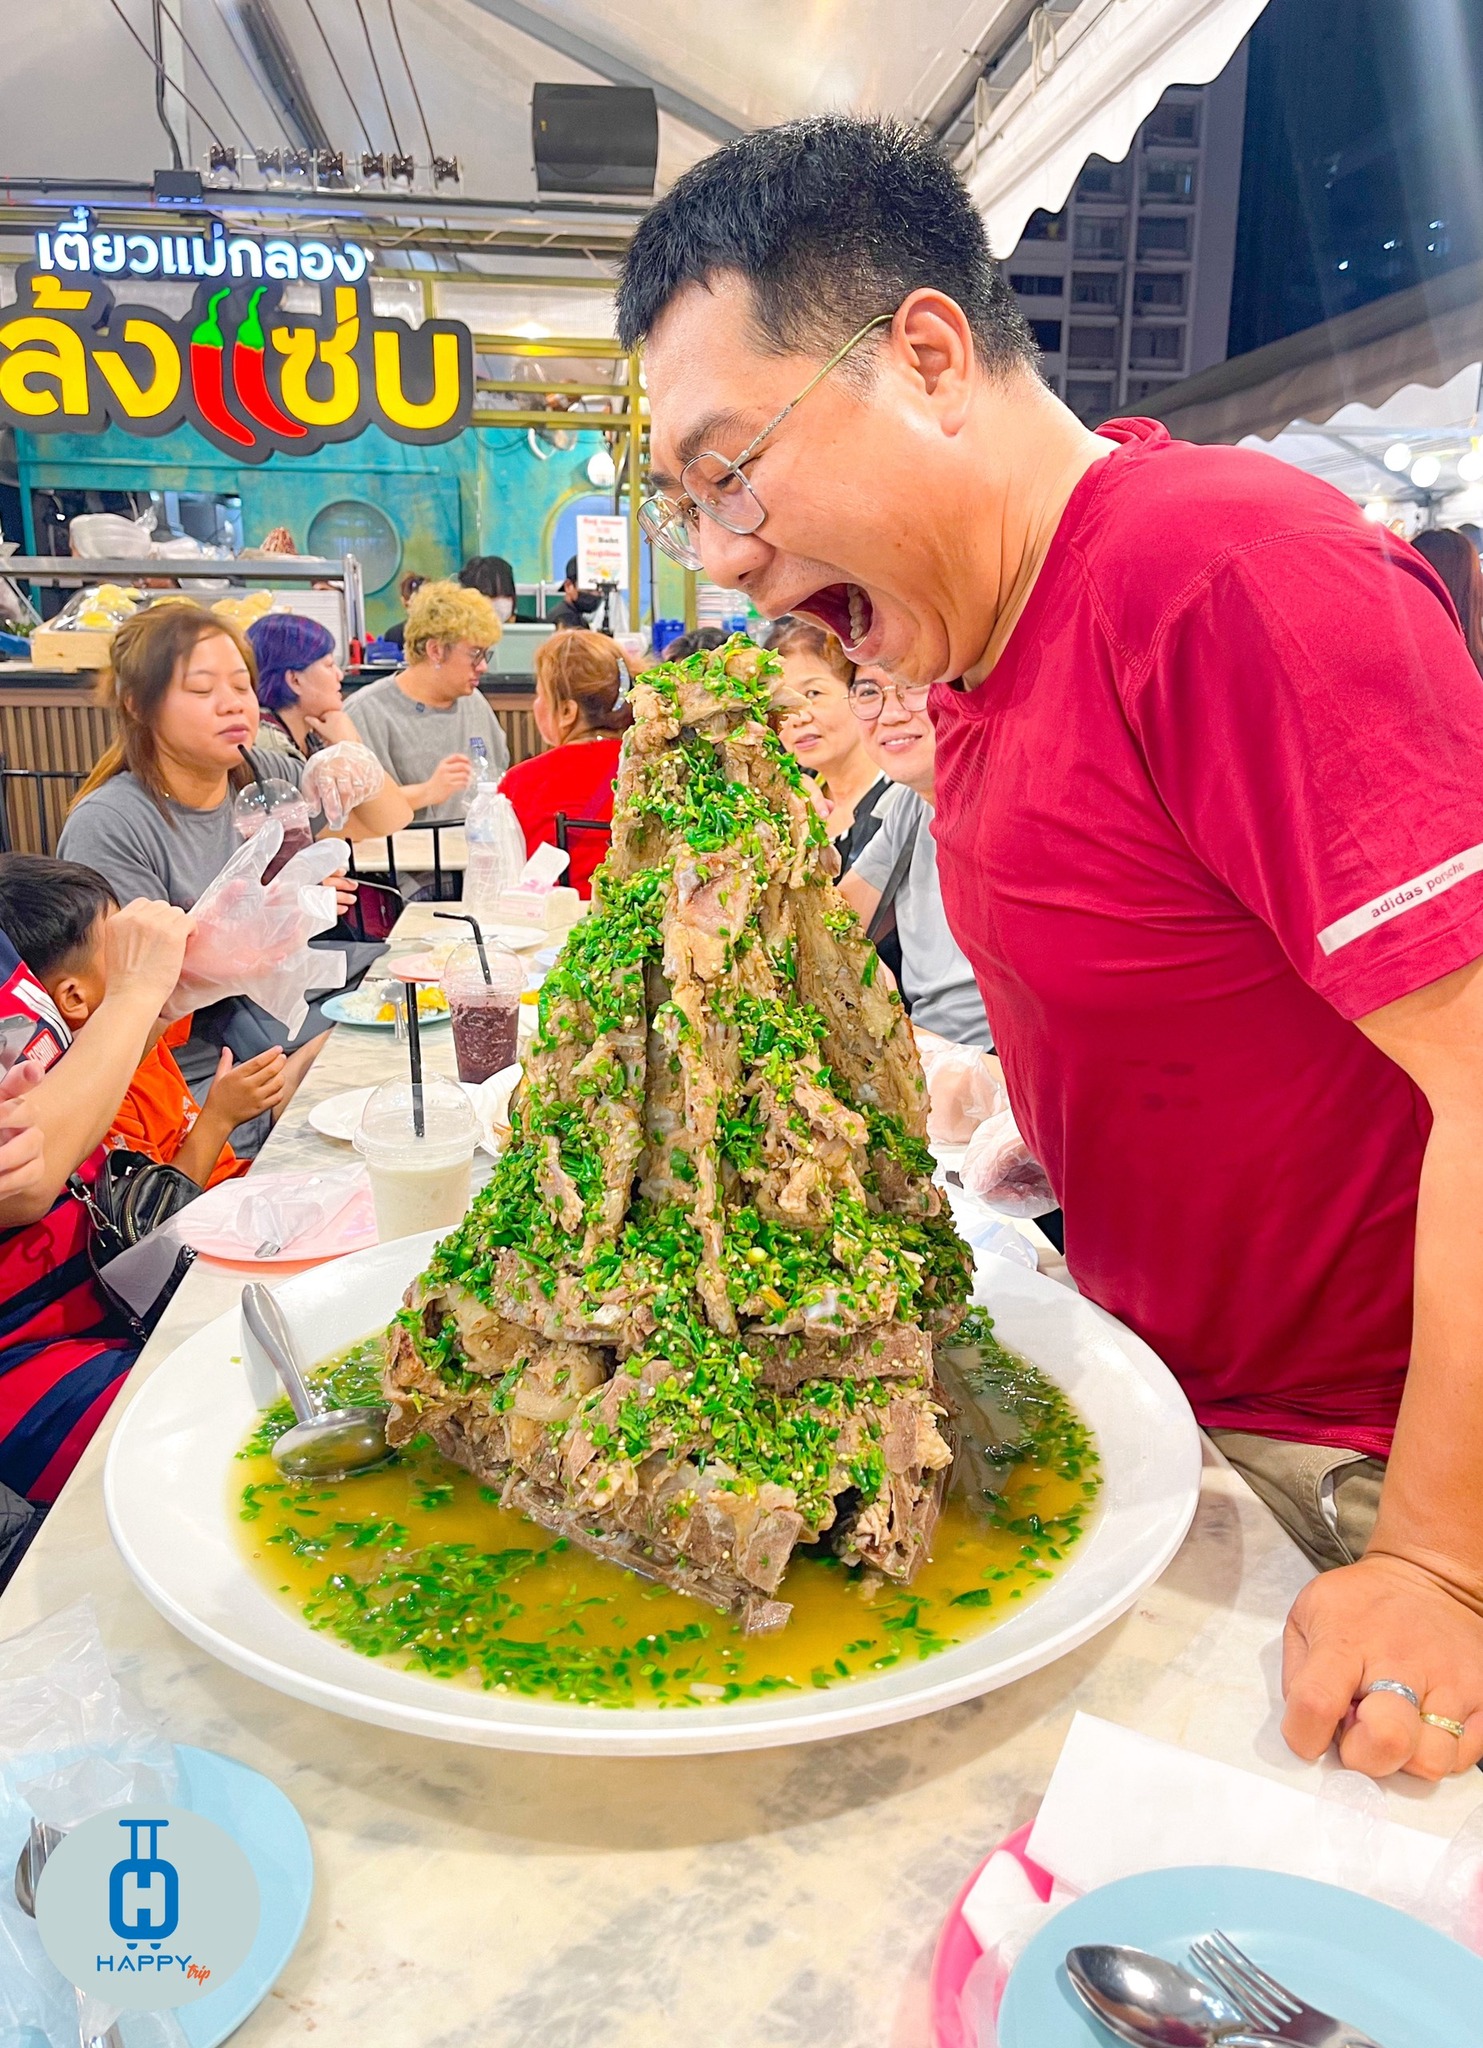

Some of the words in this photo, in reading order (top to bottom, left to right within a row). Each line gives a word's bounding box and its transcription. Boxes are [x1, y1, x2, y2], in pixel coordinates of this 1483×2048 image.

[37, 206, 367, 281] เตี๋ยวแม่กลอง
[1371, 885, 1423, 918] adidas
